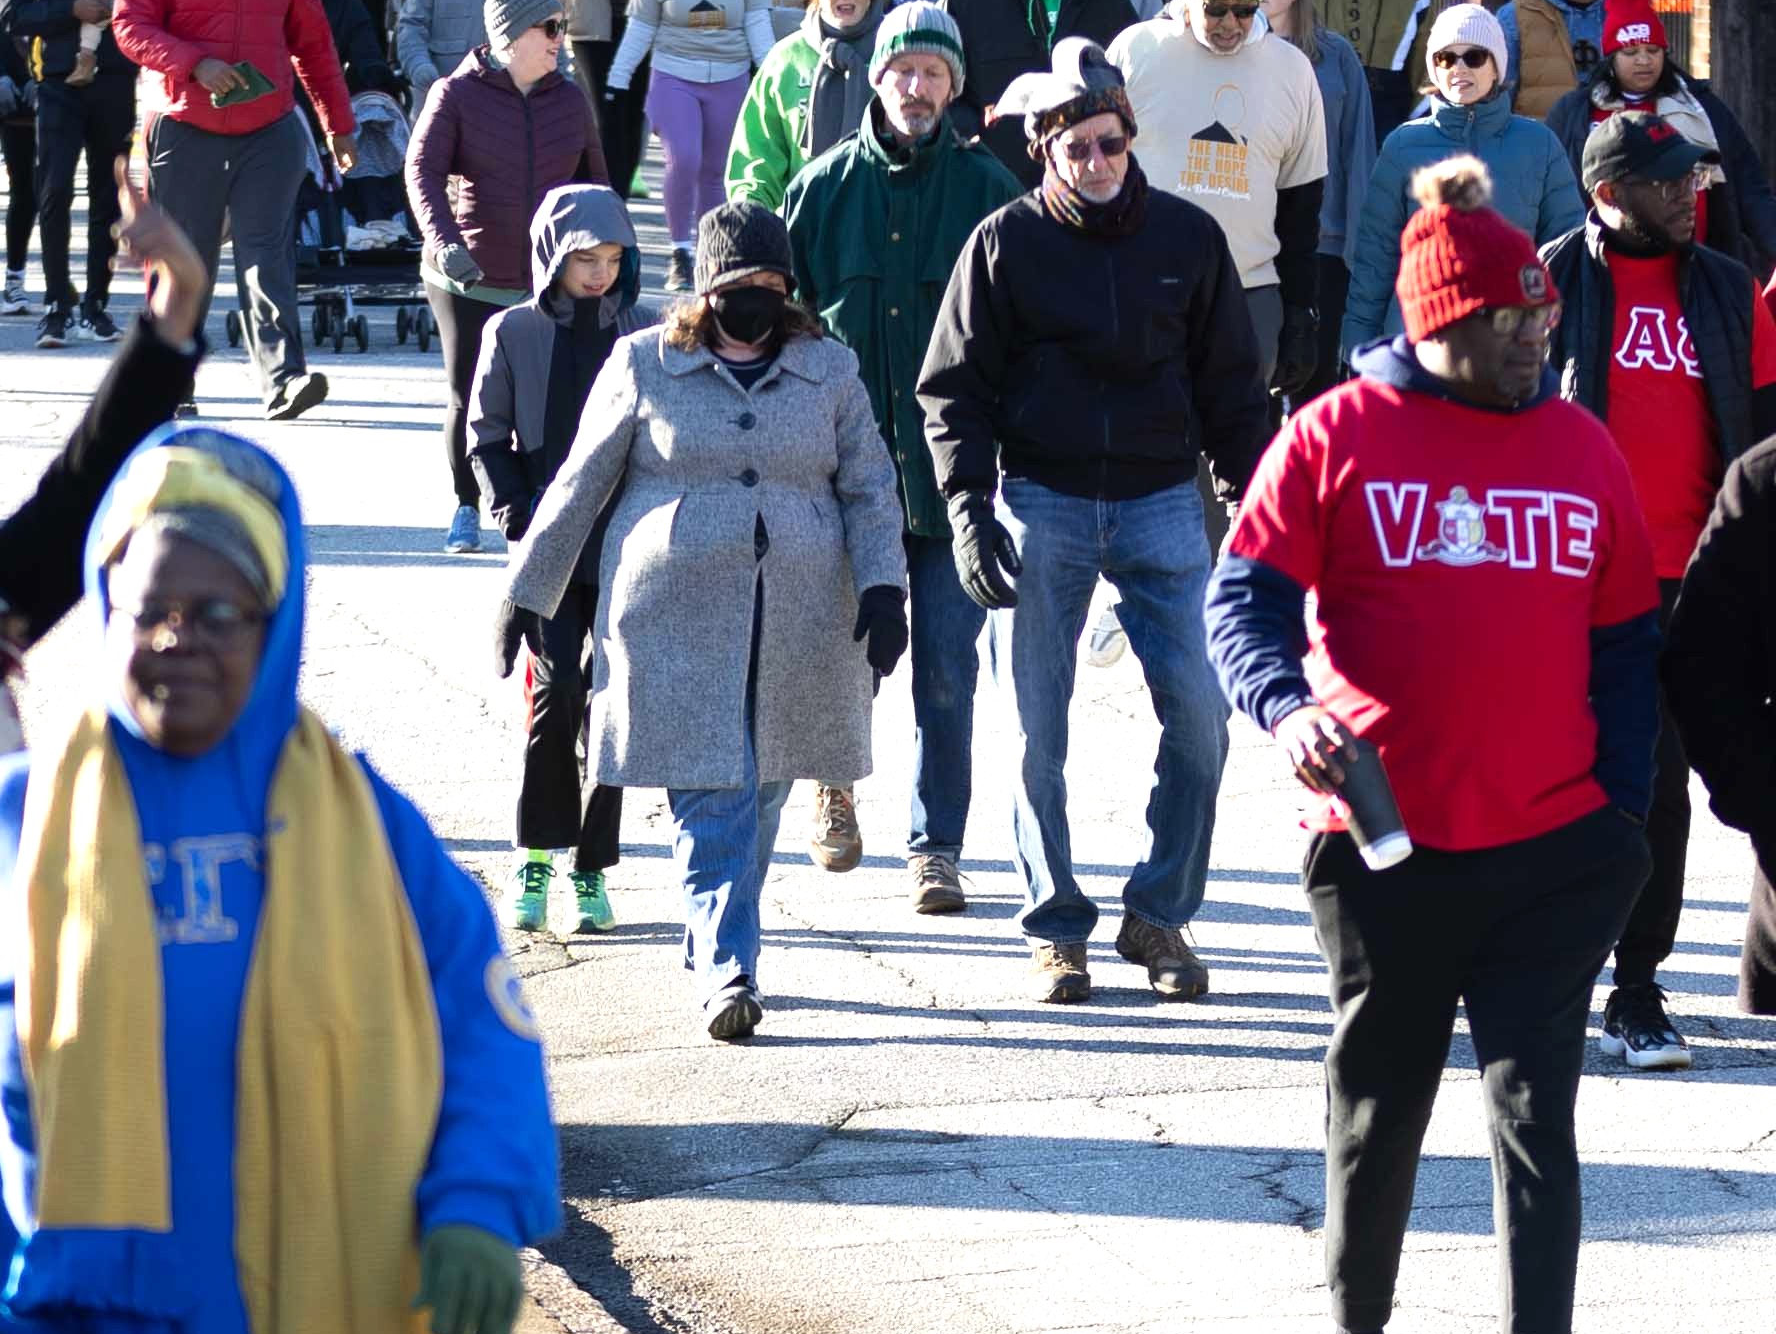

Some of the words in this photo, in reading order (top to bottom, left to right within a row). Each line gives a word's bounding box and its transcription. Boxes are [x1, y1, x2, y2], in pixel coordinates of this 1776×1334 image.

[1188, 139, 1211, 156] THE
[1187, 155, 1210, 171] THE
[1180, 171, 1203, 187] THE
